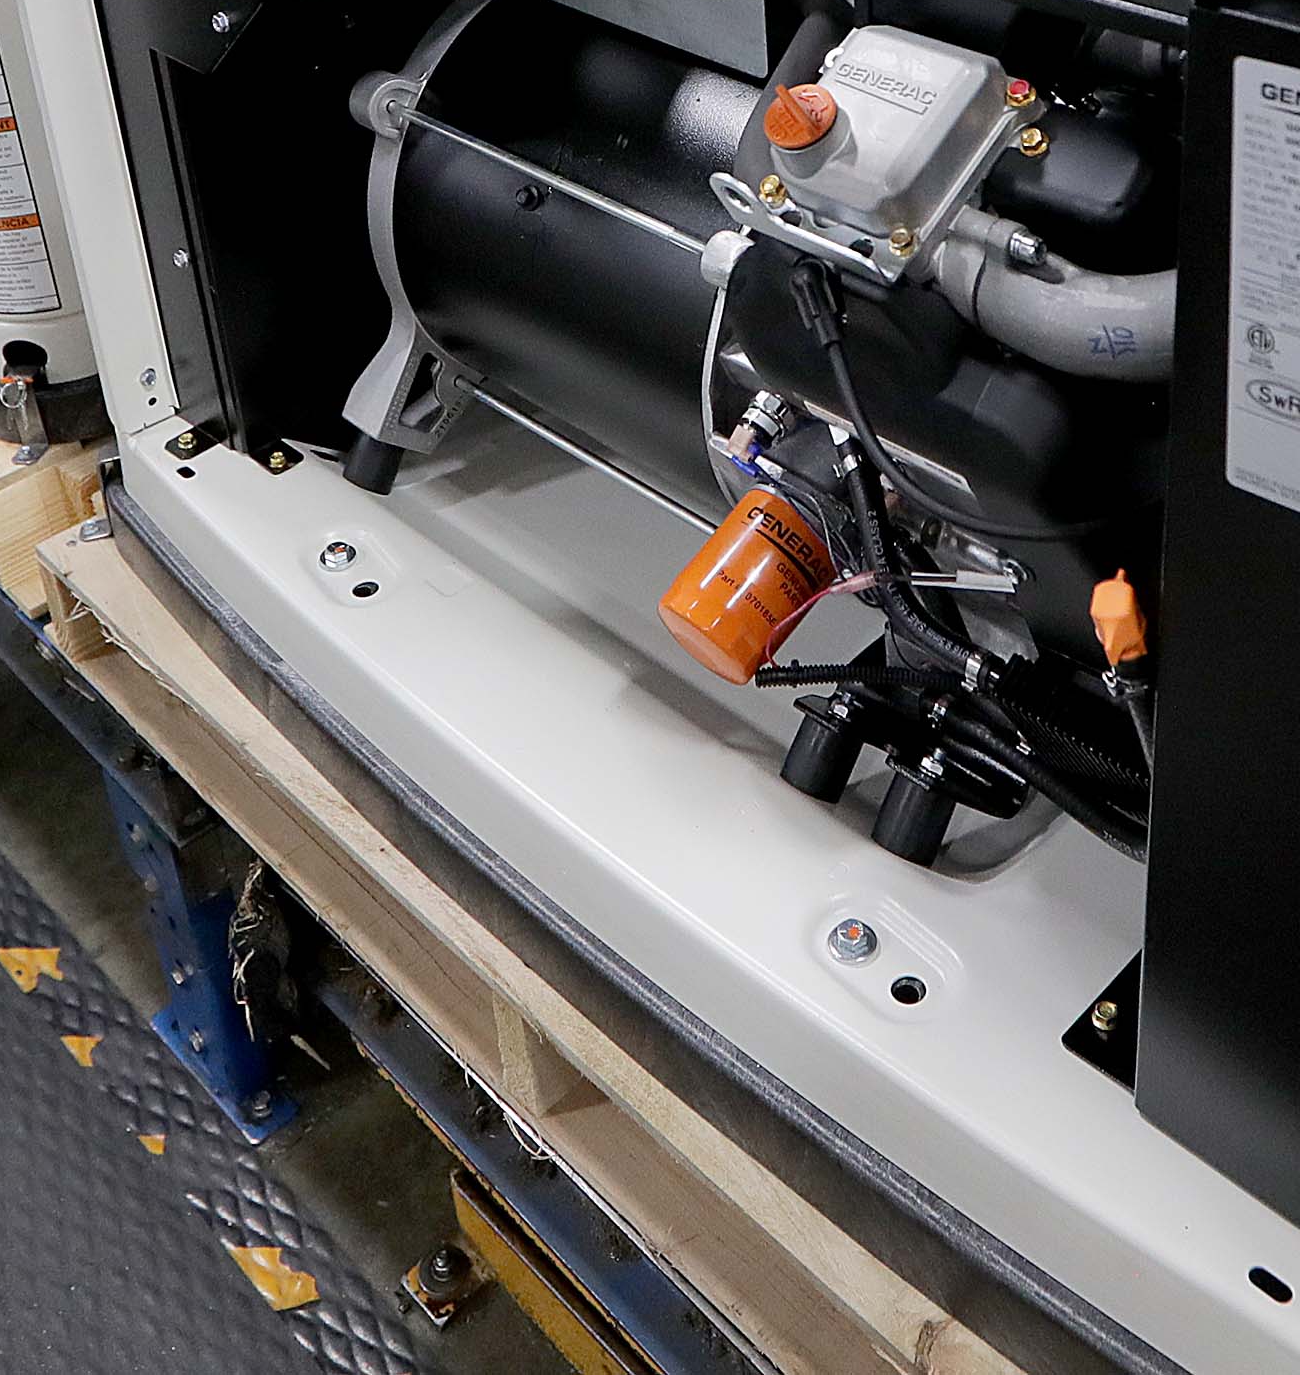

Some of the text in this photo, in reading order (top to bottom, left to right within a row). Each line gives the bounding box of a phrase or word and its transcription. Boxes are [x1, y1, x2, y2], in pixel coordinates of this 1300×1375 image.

[836, 62, 937, 106] GENERAC
[747, 506, 830, 579] GENERAC
[869, 519, 884, 556] CLASS
